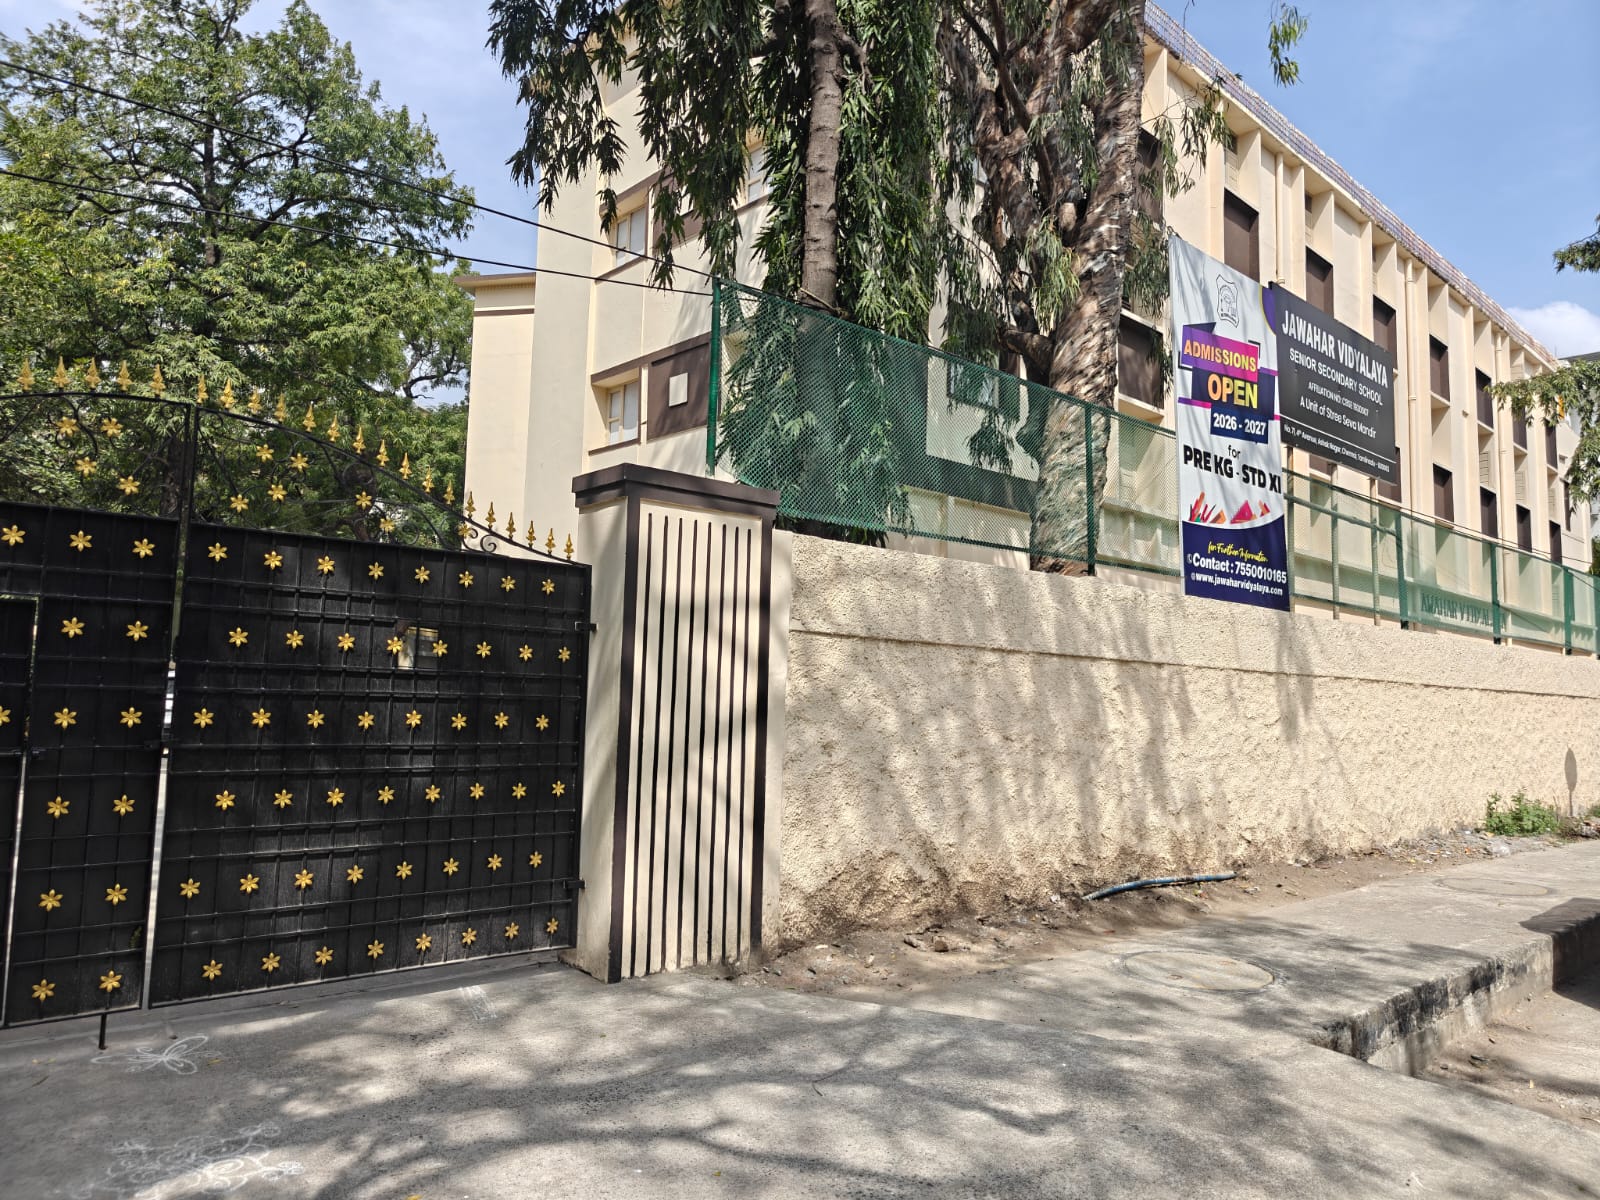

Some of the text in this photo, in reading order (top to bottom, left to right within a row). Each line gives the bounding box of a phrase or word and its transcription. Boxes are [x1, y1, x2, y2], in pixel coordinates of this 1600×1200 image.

[1184, 339, 1256, 372] ADMISSIONS
[1282, 310, 1388, 388] JAWAHAR VIDYALAYA
[1289, 347, 1383, 406] SENIOR SECONDARY SCHOOL
[1208, 373, 1258, 409] OPEN
[1300, 395, 1305, 408] A
[1305, 398, 1318, 413] Unit
[1319, 404, 1326, 416] of
[1213, 412, 1237, 430] 2026
[1244, 418, 1267, 435] 2027
[1228, 444, 1241, 458] for
[1183, 444, 1212, 472] PRE
[1214, 454, 1233, 479] KG
[1242, 463, 1267, 489] STD
[1195, 572, 1283, 596] www.jawaharvidyalaya.com
[1235, 561, 1287, 584] 7550010165
